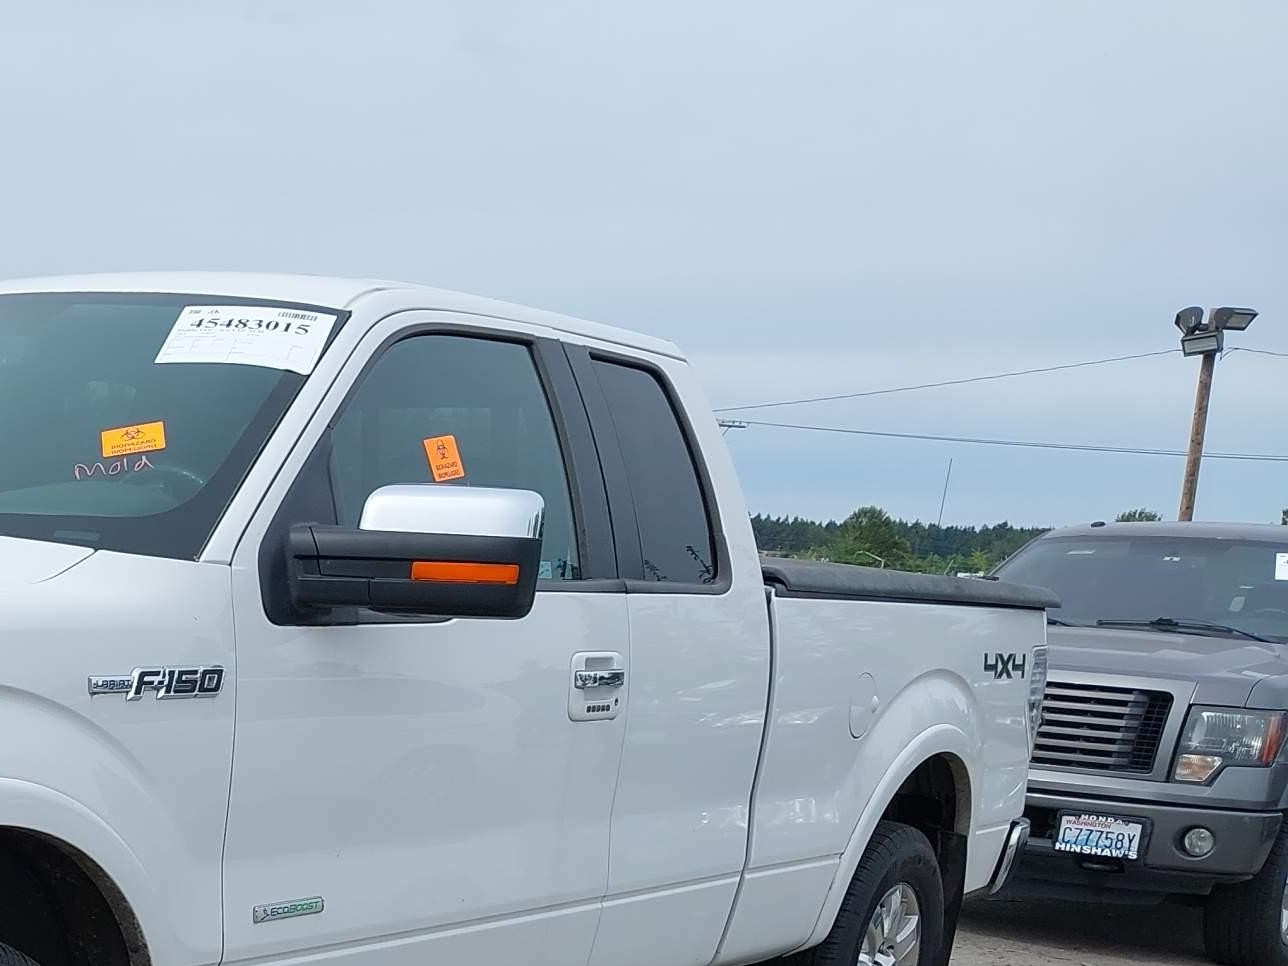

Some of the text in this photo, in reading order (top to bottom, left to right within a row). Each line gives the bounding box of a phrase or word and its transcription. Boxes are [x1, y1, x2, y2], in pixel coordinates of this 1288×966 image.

[190, 317, 312, 337] 45483015
[983, 652, 1027, 680] 4X4
[130, 668, 224, 698] F-150
[1079, 813, 1123, 826] HONDA
[1062, 826, 1136, 851] C77758Y
[1054, 841, 1138, 860] HINSHAW'S
